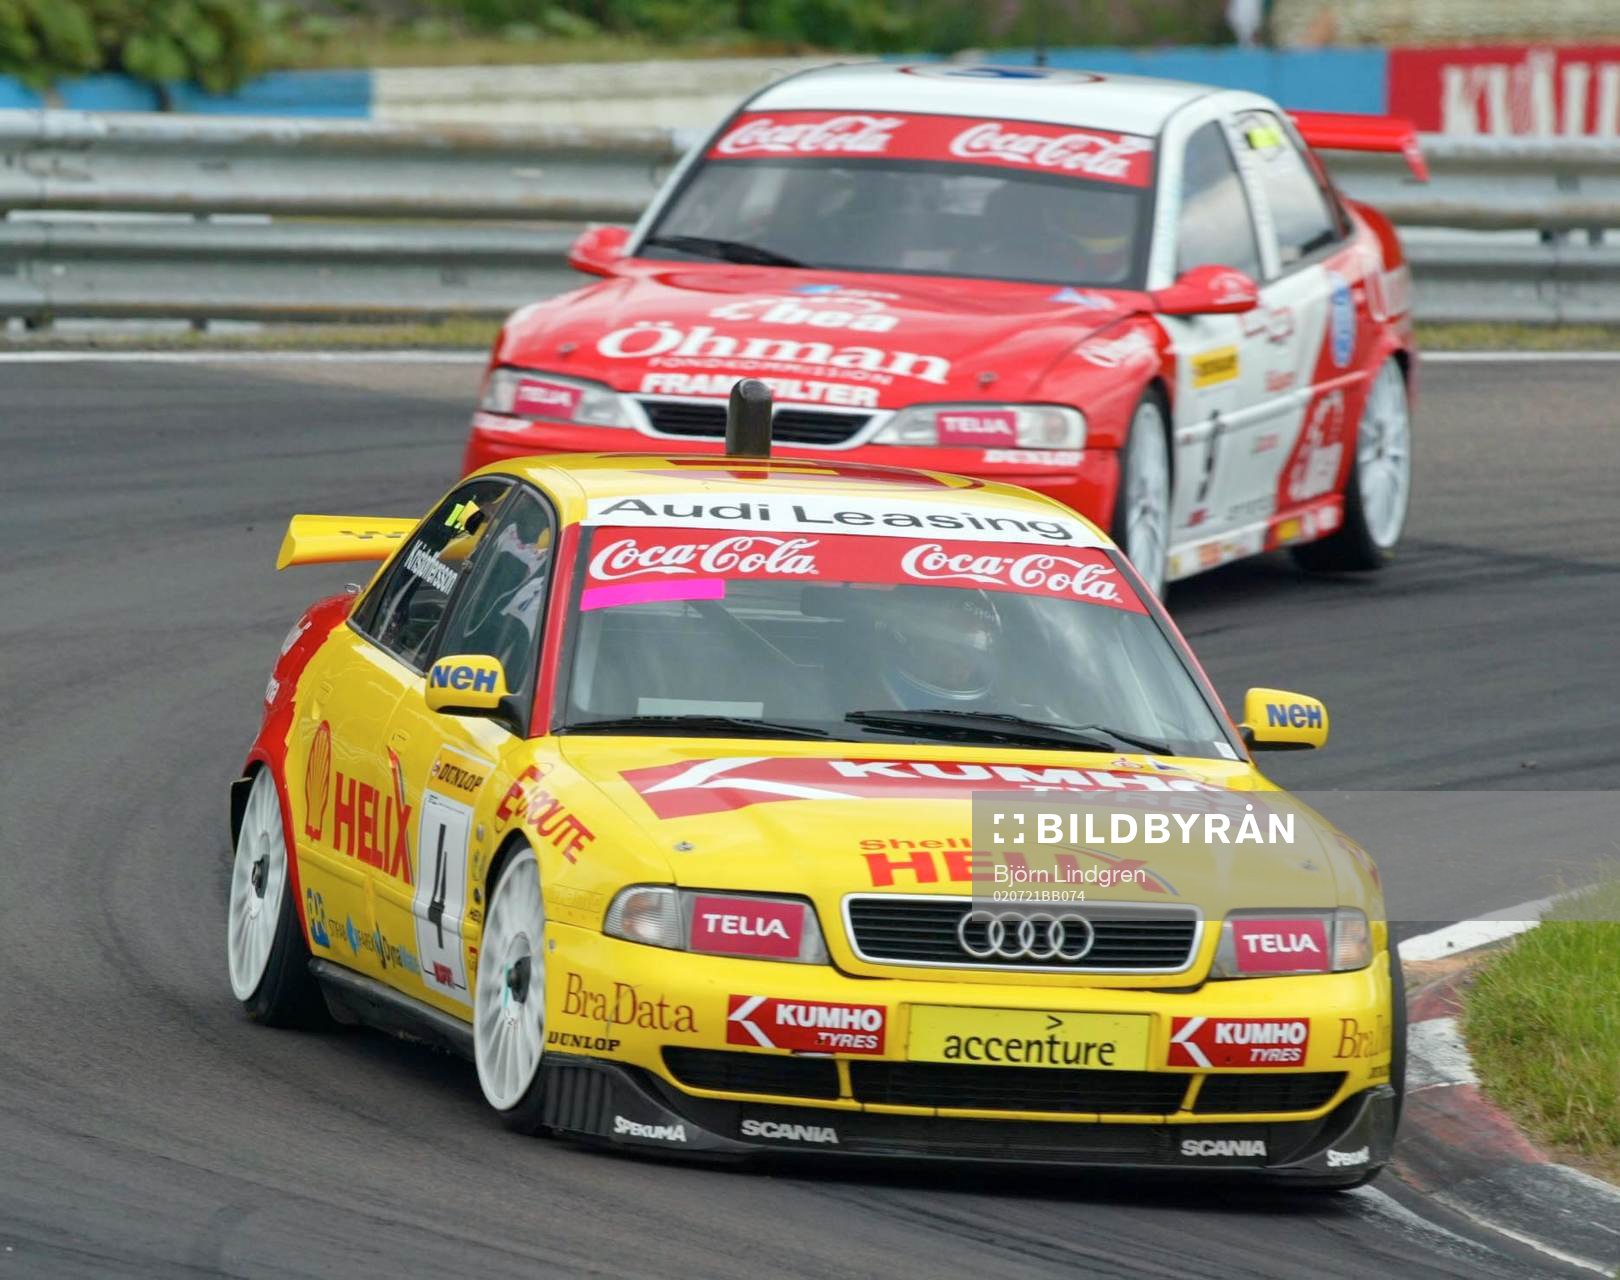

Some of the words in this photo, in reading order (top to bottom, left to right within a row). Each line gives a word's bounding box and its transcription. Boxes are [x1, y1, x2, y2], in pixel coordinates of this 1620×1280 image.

[596, 320, 952, 384] Öhman
[597, 498, 771, 522] Audi
[791, 504, 1073, 540] Leasing
[588, 535, 820, 580] Coca-Cola
[901, 543, 1123, 604] Coca-Cola
[333, 750, 413, 886] HELIX
[859, 838, 973, 850] Shell
[860, 850, 1168, 894] HELIX
[427, 822, 448, 952] 4
[702, 913, 791, 939] TELIA
[1242, 933, 1321, 953] TELIA
[775, 1003, 882, 1030] KUMHO
[547, 1031, 622, 1051] DUNLOP
[817, 1031, 878, 1049] TYRES
[1215, 1022, 1307, 1045] KUMHO
[943, 1033, 1116, 1066] accenture
[1250, 1048, 1302, 1062] TYRES
[614, 1115, 687, 1142] SPEKUMA
[740, 1119, 839, 1143] SCANIA
[1180, 1139, 1267, 1156] SCANIA
